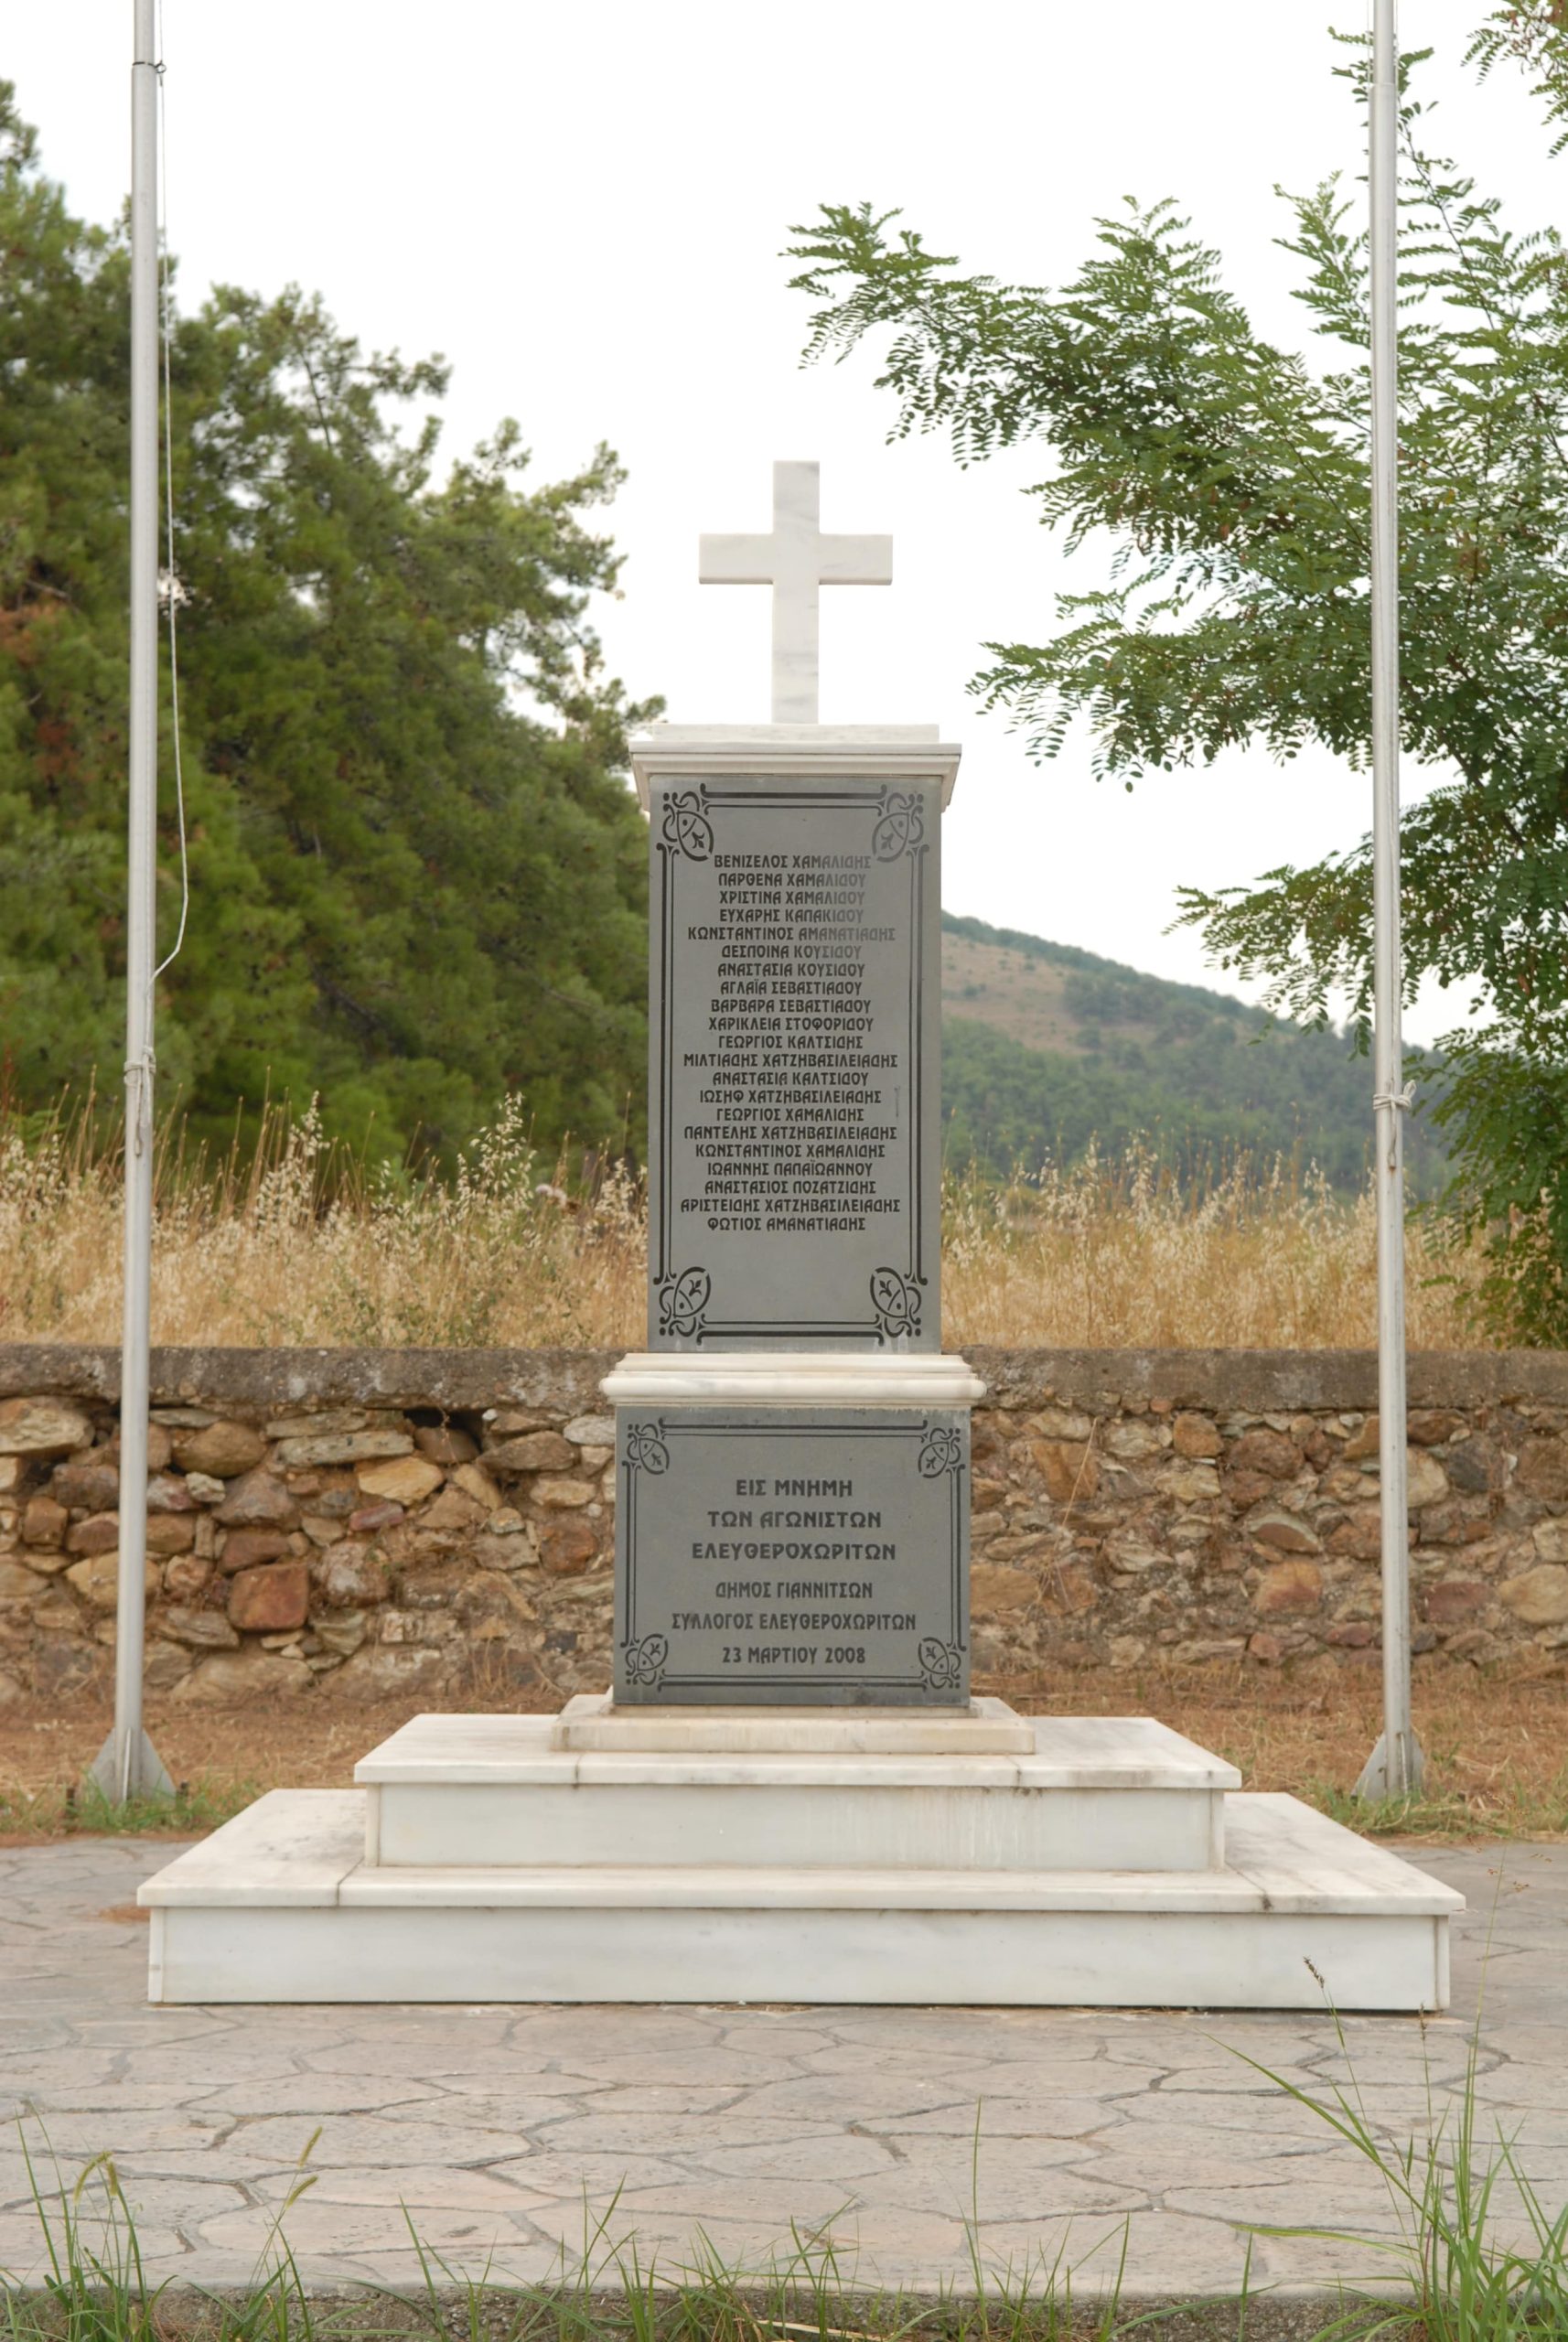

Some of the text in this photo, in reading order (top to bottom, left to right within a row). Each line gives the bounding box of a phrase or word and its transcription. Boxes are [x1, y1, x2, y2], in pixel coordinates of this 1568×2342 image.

[714, 854, 872, 868] ΒΕΝΙΖΕΛΟΣ ΧΑΜΑΛΙΔΗΣ
[718, 873, 866, 886] ΠΑΡΘΕΝΑ ΧΑΜΑΛΙΔΟΥ
[719, 891, 865, 904] ΧΡΙΣΤΙΝΑ ΧΑΜΑΛΙΔΟΥ
[720, 909, 864, 922] ΕΥΧΑΡΗΣ ΚΑΠΑΚΙΔΟΥ
[688, 927, 896, 940] ΚΩΝΣΤΑΝΤΙΝΟΣ ΑΜΑΝΑΤΙΑΔΗΣ
[722, 945, 861, 959] ΔΕΣΠΟΙΝΑ ΚΟΥΣΙΔΟΥ
[718, 963, 865, 977] ΑΝΑΣΤΑΣΙΑ ΚΟΥΣΙΔΟΥ
[772, 982, 862, 995] ΣΕΒΑΣΤΙΑΔΟΥ
[711, 999, 871, 1013] ΒΑΡΒΑΡΑ ΣΕΒΑΣΤΙΑΔΟΥ
[709, 1017, 874, 1031] ΧΑΡΙΚΛΕΙΑ ΣΤΟΦΟΡΙΔΟΥ
[719, 1036, 863, 1049] ΓΕΩΡΓΙΟΣ ΚΑΛΤΣΙΔΗΣ
[683, 1054, 898, 1068] ΜΙΛΤΙΑΔΗΣ ΧΑΤΖΗΒΑΣΙΛΕΙΑΔΗΣ
[713, 1072, 868, 1086] ΑΝΑΣΤΑΣΙΑ ΚΑΛΤΣΙΔΟΥ
[700, 1090, 881, 1103] ΙΩΣΗΦ ΧΑΤΖΗΒΑΣΙΛΕΙΑΔΗΣ
[717, 1108, 864, 1122] ΓΕΩΡΓΙΟΣ ΧΑΜΑΛΙΔΗΣ
[684, 1126, 897, 1140] ΠΑΝΤΕΛΗΣ ΧΑΤΖΗΒΑΣΙΛΕΙΑΔΗΣ
[696, 1144, 885, 1158] ΚΩΝΣΤΑΝΤΙΝΟΣ ΧΑΜΑΛΙΔΗΣ
[708, 1163, 768, 1176] ΙΩΑΝΝΗΣ
[705, 1181, 876, 1195] ΑΝΑΣΤΑΣΙΟΣ ΠΟΖΑΤΖΙΔΗΣ
[681, 1199, 900, 1213] ΑΡΙΣΤΕΙΔΗΣ ΧΑΤΖΗΒΑΣΙΛΕΙΑΔΗΣ
[707, 1217, 865, 1231] ΦΩΤΙΟΣ ΑΜΑΝΑΤΙΑΔΗΣ
[736, 1479, 853, 1497] ΕΙΣ ΜΝΗΜΗ
[707, 1511, 882, 1529] ΤΩΝ ΑΓΩΝΙΣΤΩΝ
[692, 1542, 896, 1561] ΕΛΕΥΘΕΡΟΧΩΡΙΤΩΝ
[715, 1582, 873, 1599] ΔΗΜΟΣ ΓΙΑΝΝΙΤΣΩΝ
[671, 1613, 917, 1631] ΣΥΛΛΟΓΟΣ ΕΛΕΥΘΕΡΟΧΩΡΙΤΩΝ
[723, 1647, 866, 1664] 23 ΜΑΡΤΙΟΥ 2008
